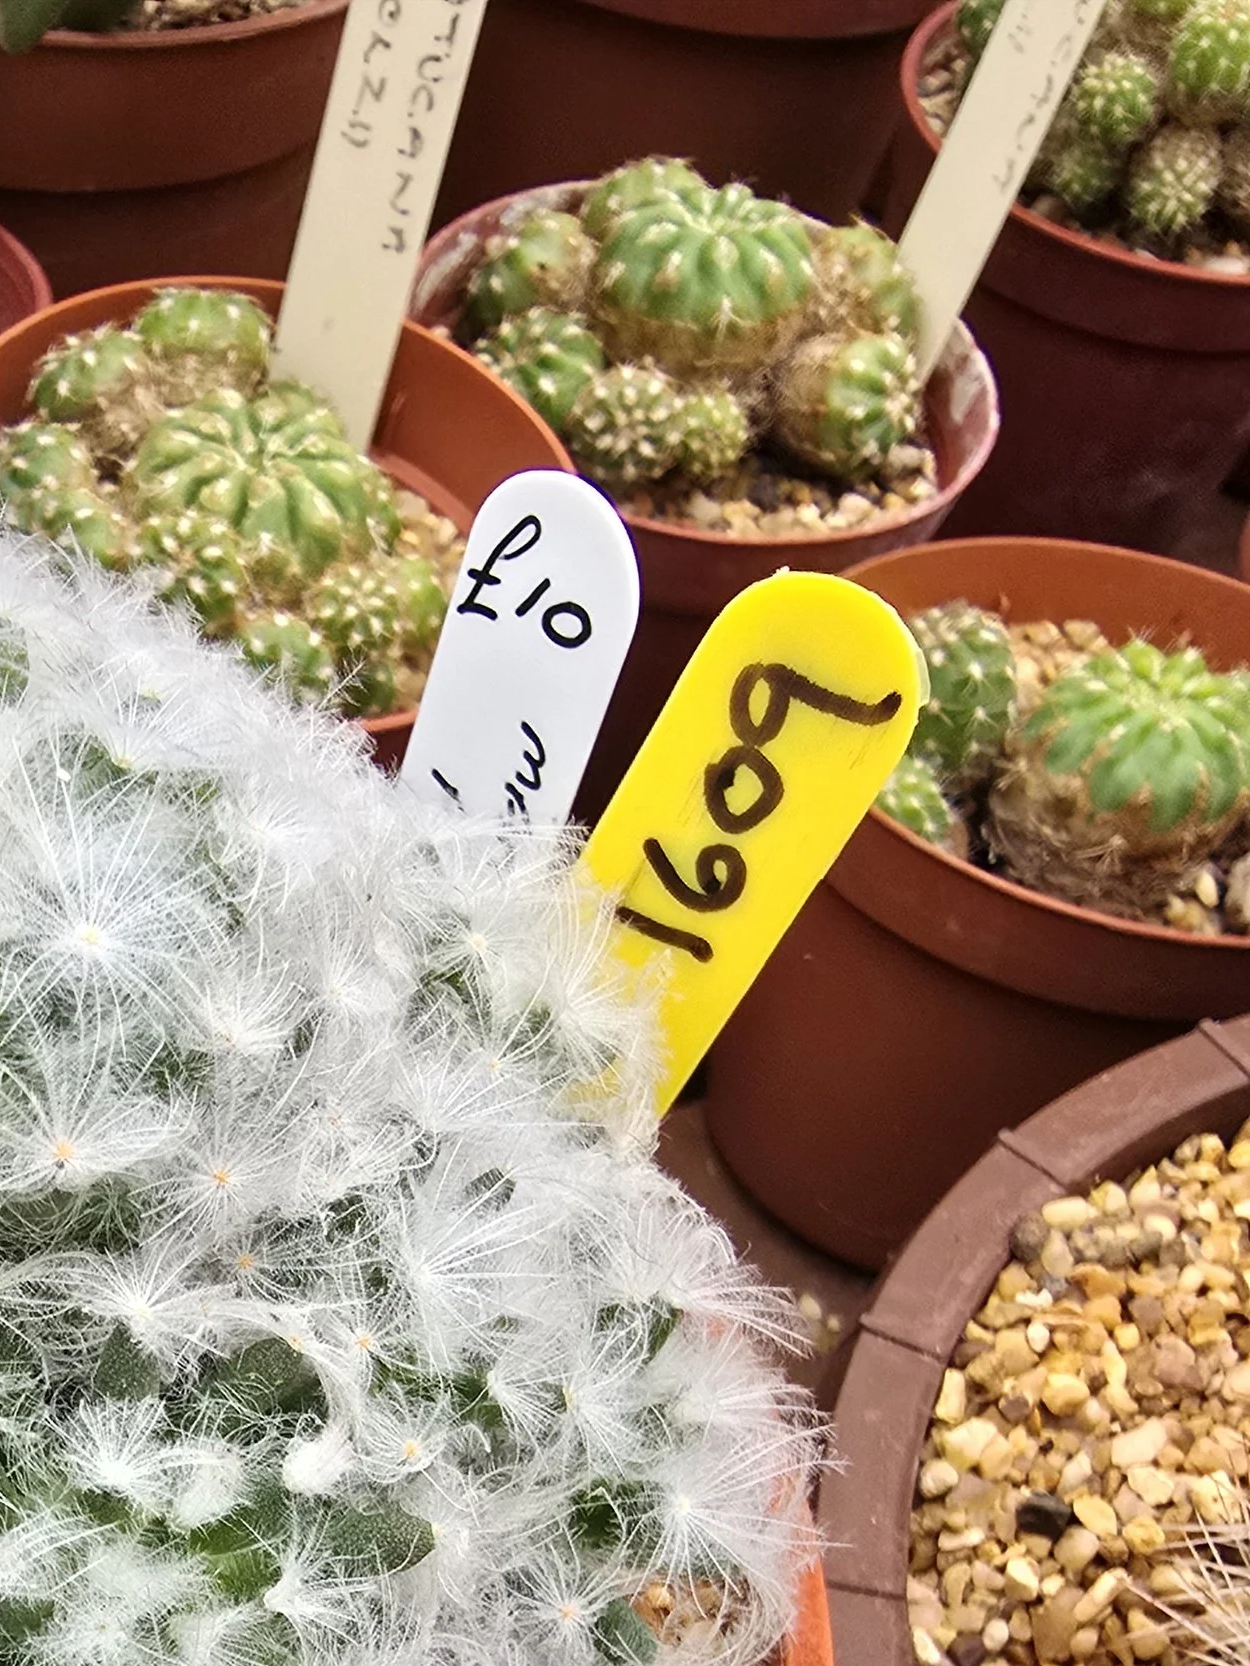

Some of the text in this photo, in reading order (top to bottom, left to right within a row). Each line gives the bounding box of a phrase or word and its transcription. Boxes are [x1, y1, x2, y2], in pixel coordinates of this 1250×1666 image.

[382, 0, 463, 254] TUCANA
[457, 515, 592, 649] £10
[615, 662, 902, 963] 1609
